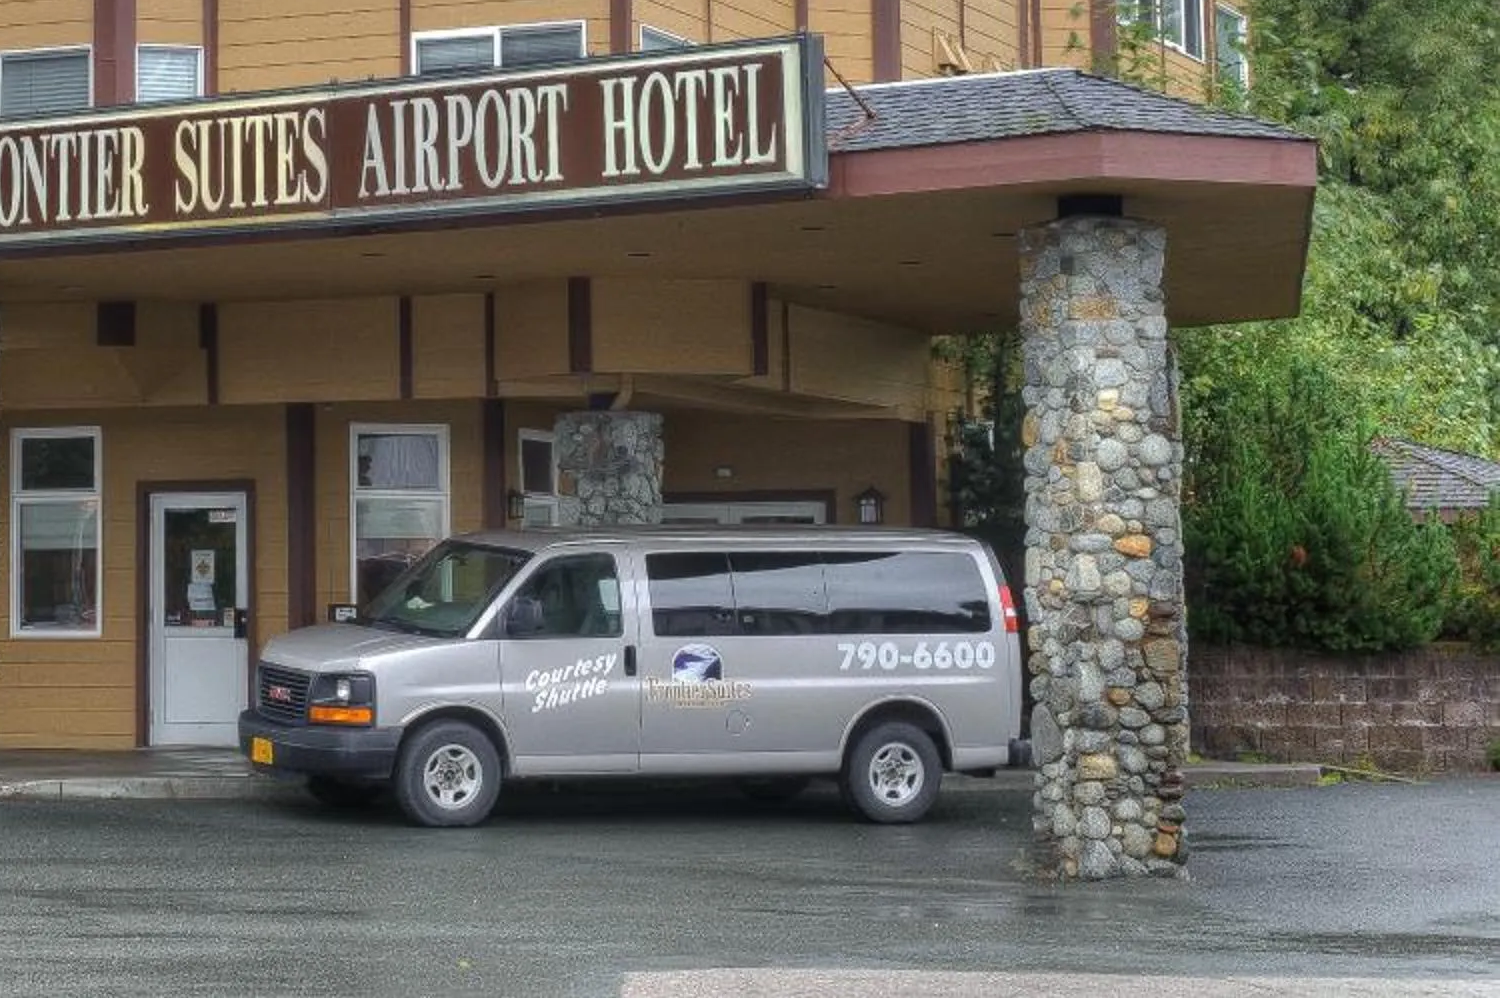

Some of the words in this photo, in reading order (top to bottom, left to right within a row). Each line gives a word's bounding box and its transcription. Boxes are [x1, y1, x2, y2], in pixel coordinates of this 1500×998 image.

[175, 107, 329, 214] SUITES
[358, 83, 569, 199] AIRPORT
[600, 63, 778, 177] HOTEL
[525, 651, 618, 691] Courtesy
[837, 641, 996, 670] 790-6600
[531, 678, 609, 713] Shuttle
